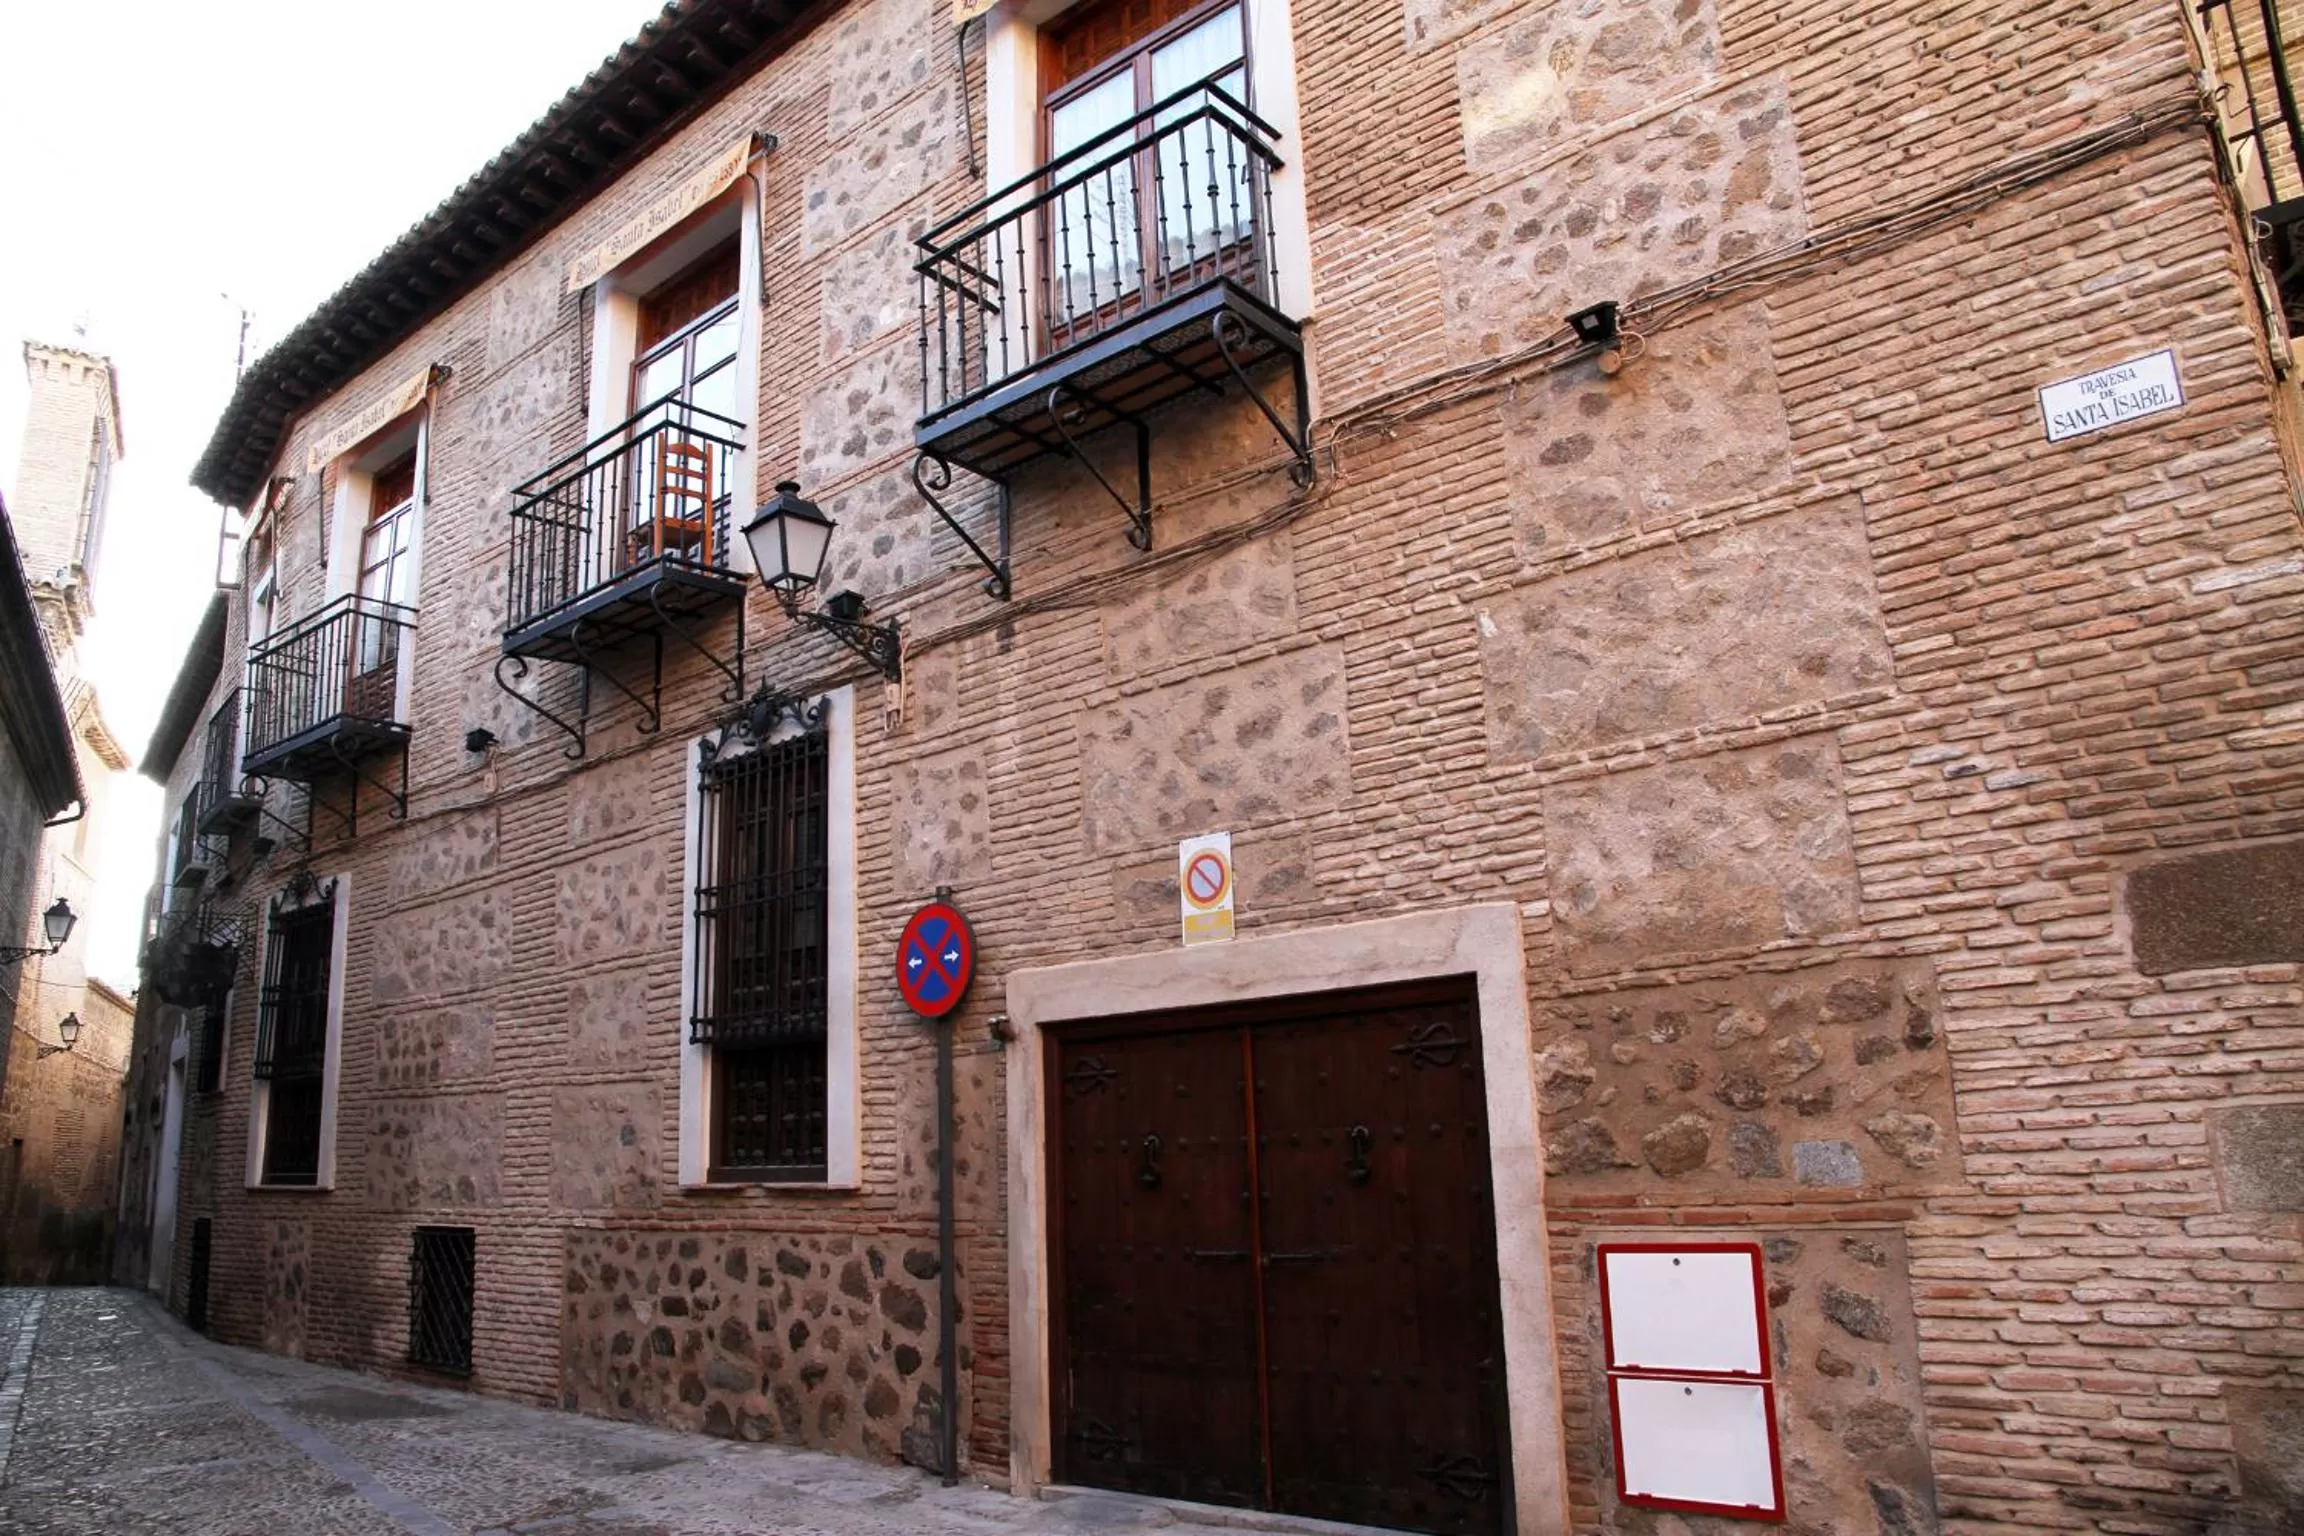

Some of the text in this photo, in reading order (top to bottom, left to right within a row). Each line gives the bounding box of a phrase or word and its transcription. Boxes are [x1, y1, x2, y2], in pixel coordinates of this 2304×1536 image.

[2079, 368, 2137, 395] TRAVESIA
[2100, 388, 2117, 400] DE
[2053, 384, 2174, 434] SANTA ISABEL
